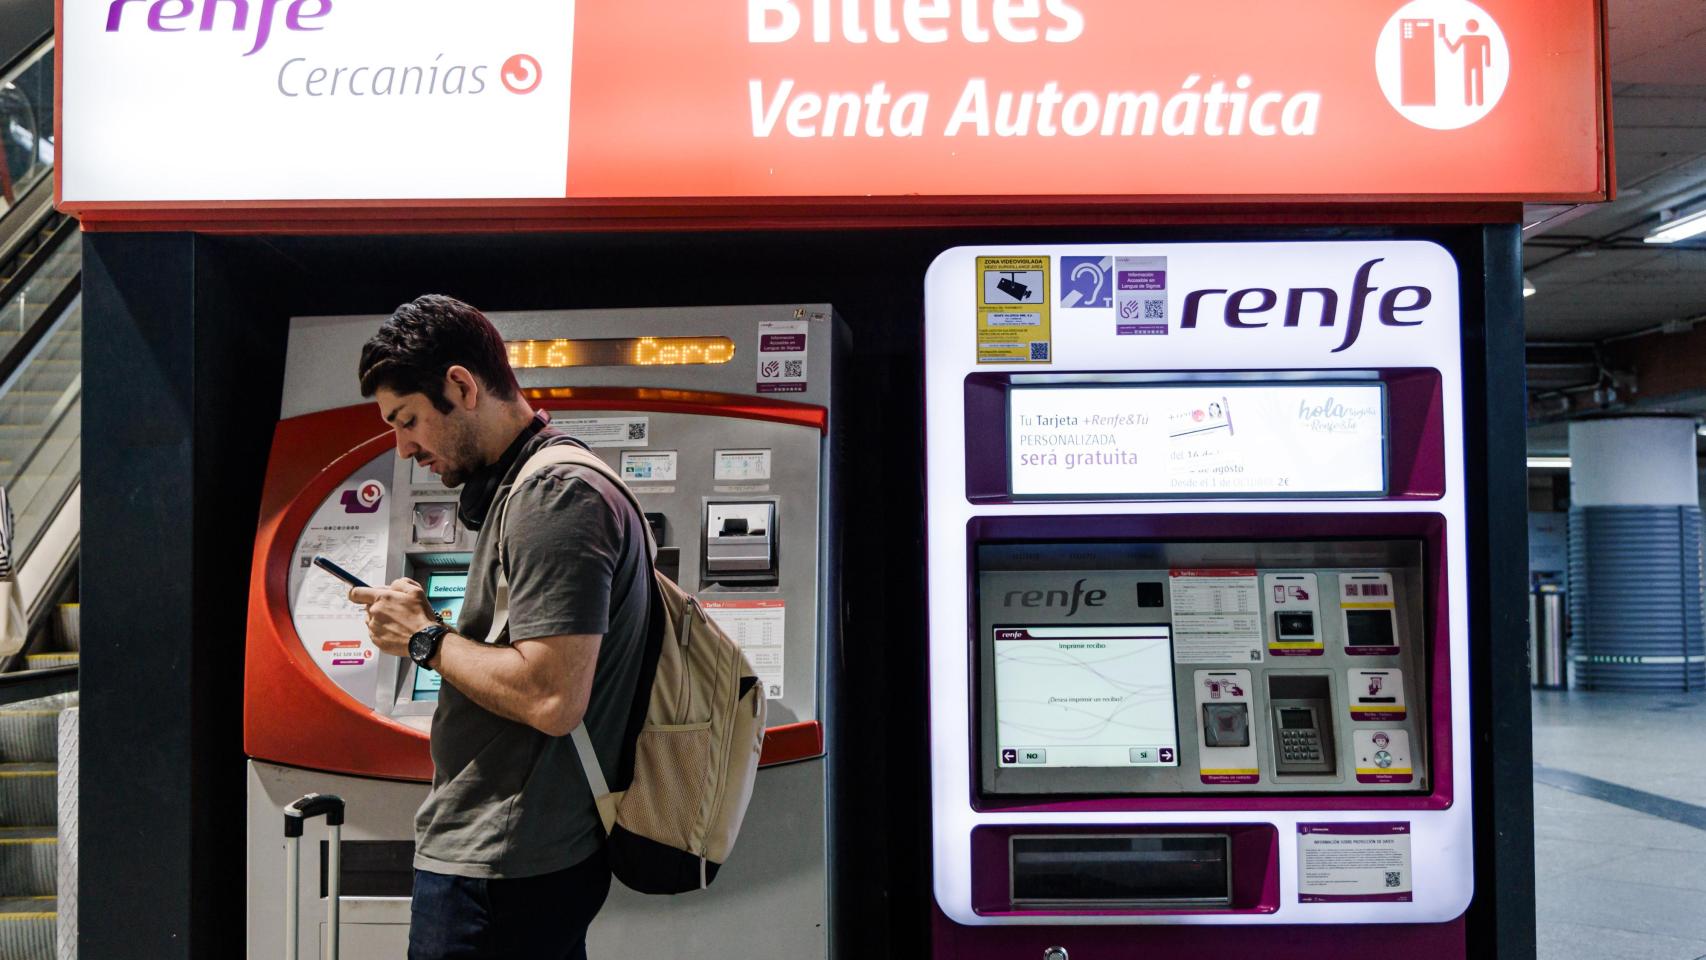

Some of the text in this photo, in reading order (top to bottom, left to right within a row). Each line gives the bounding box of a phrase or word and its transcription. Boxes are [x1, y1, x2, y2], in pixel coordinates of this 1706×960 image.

[105, 0, 334, 57] renfe
[748, 0, 1085, 44] Billetes
[277, 53, 489, 97] Cercanías
[747, 73, 1322, 138] Venta Automática
[1103, 297, 1112, 307] T
[1180, 258, 1432, 353] renfe
[1020, 414, 1032, 426] Tu
[1037, 414, 1078, 428] Tarjeta
[1299, 397, 1345, 420] hola
[1020, 434, 1117, 446] PERSONALIZADA
[1020, 448, 1138, 469] será gratuita
[1004, 579, 1107, 617] renfe
[1002, 631, 1023, 639] renfe
